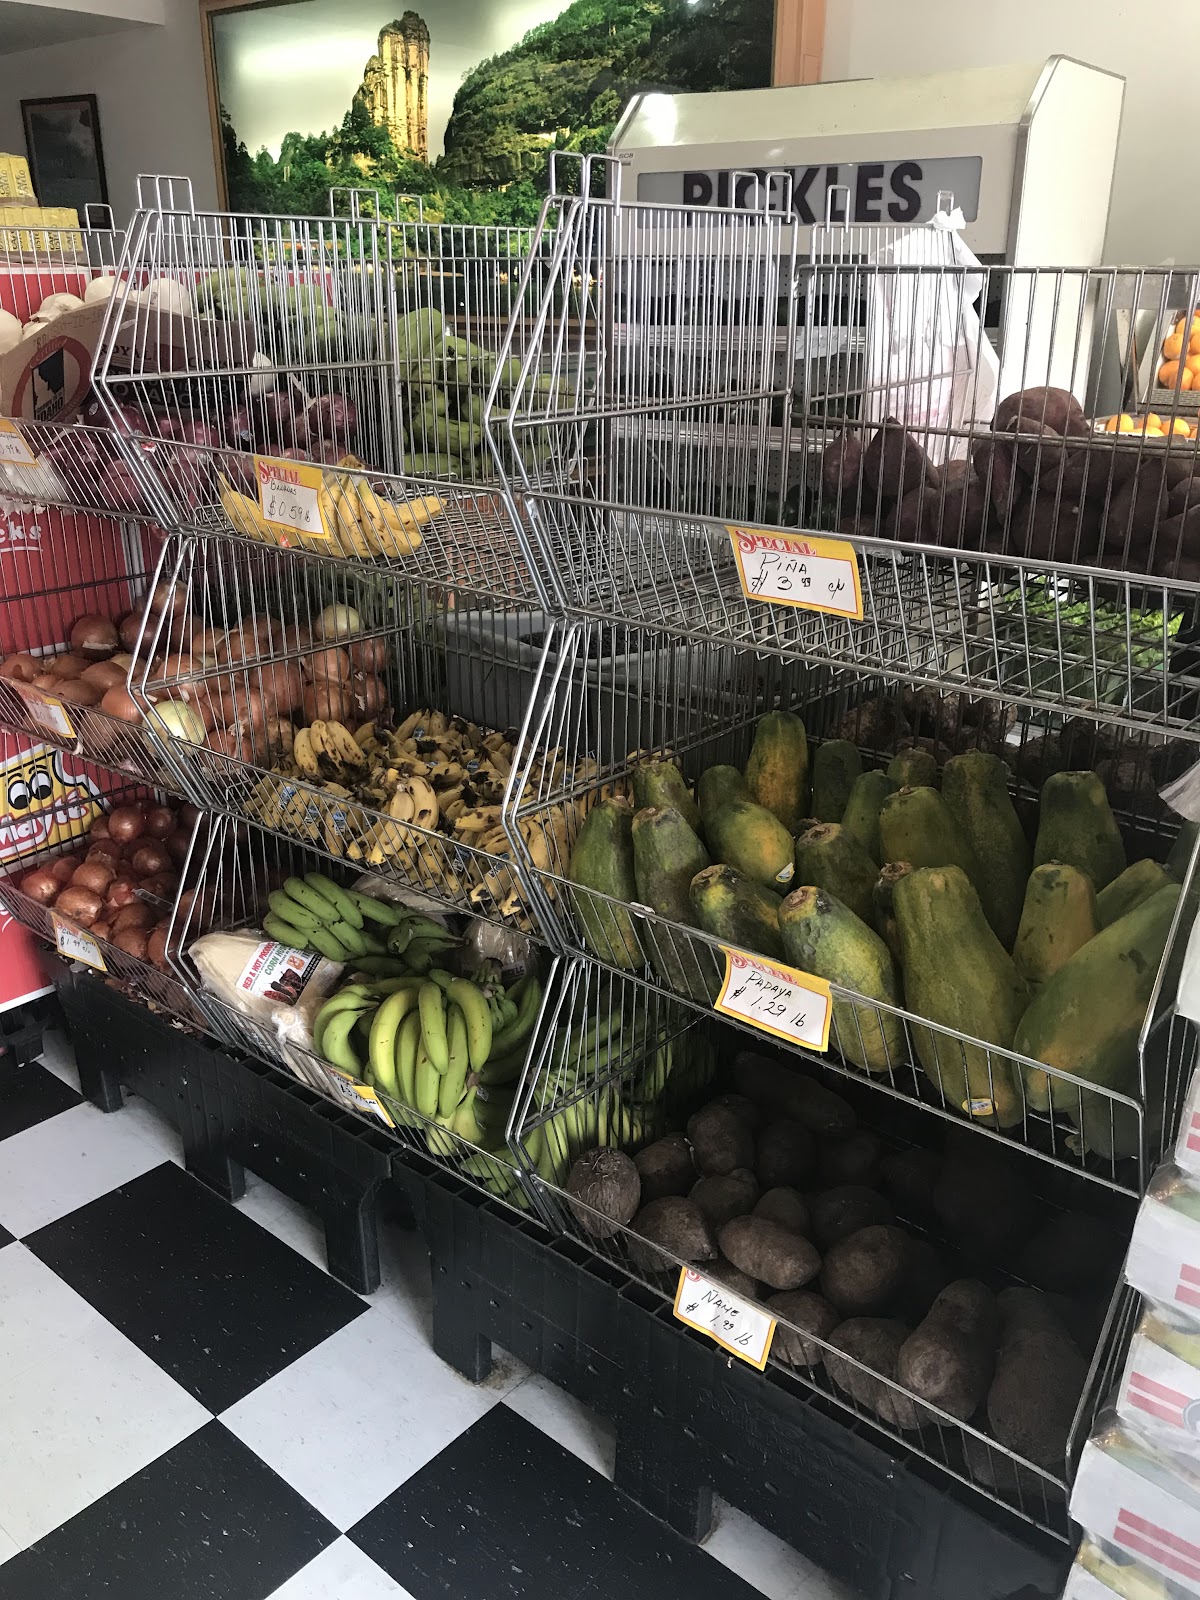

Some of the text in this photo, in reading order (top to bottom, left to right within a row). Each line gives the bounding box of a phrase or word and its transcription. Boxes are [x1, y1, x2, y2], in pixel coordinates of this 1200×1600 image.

[682, 162, 923, 226] PICKLES
[257, 460, 302, 485] SPECIAL
[734, 529, 817, 557] SPECIAL
[242, 976, 255, 991] RED
[251, 957, 263, 973] HOT
[264, 955, 280, 976] CORN
[745, 970, 793, 1000] PAPAYA
[750, 996, 787, 1018] 1.29
[789, 1012, 807, 1028] lb
[733, 1331, 754, 1346] lb
